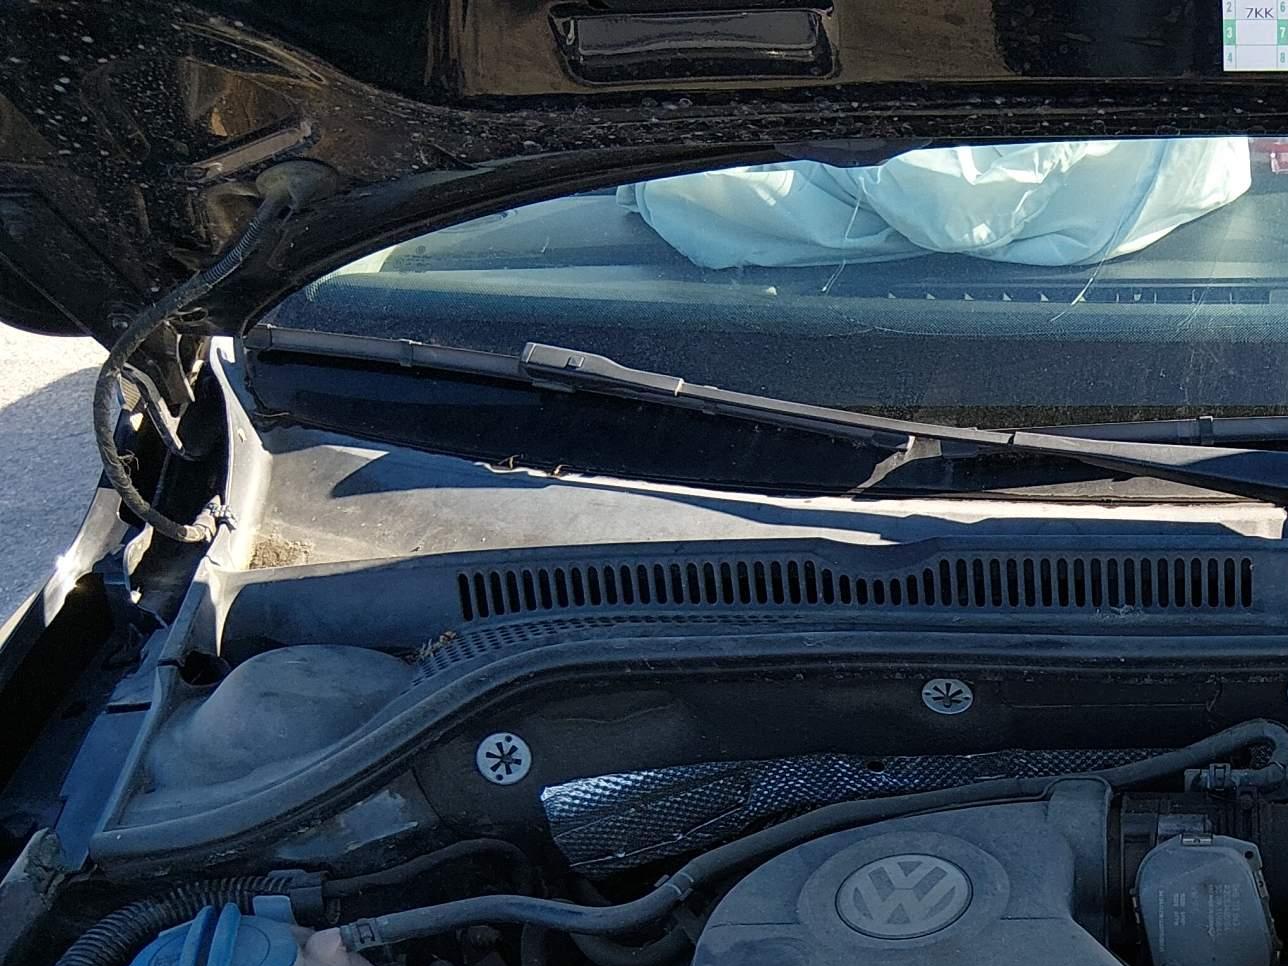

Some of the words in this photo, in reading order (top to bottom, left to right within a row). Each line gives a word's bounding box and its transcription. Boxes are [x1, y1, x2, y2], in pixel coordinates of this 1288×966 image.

[1280, 2, 1286, 12] 6
[1246, 7, 1275, 19] 7KK
[1226, 27, 1233, 38] 3
[1280, 27, 1287, 38] 7
